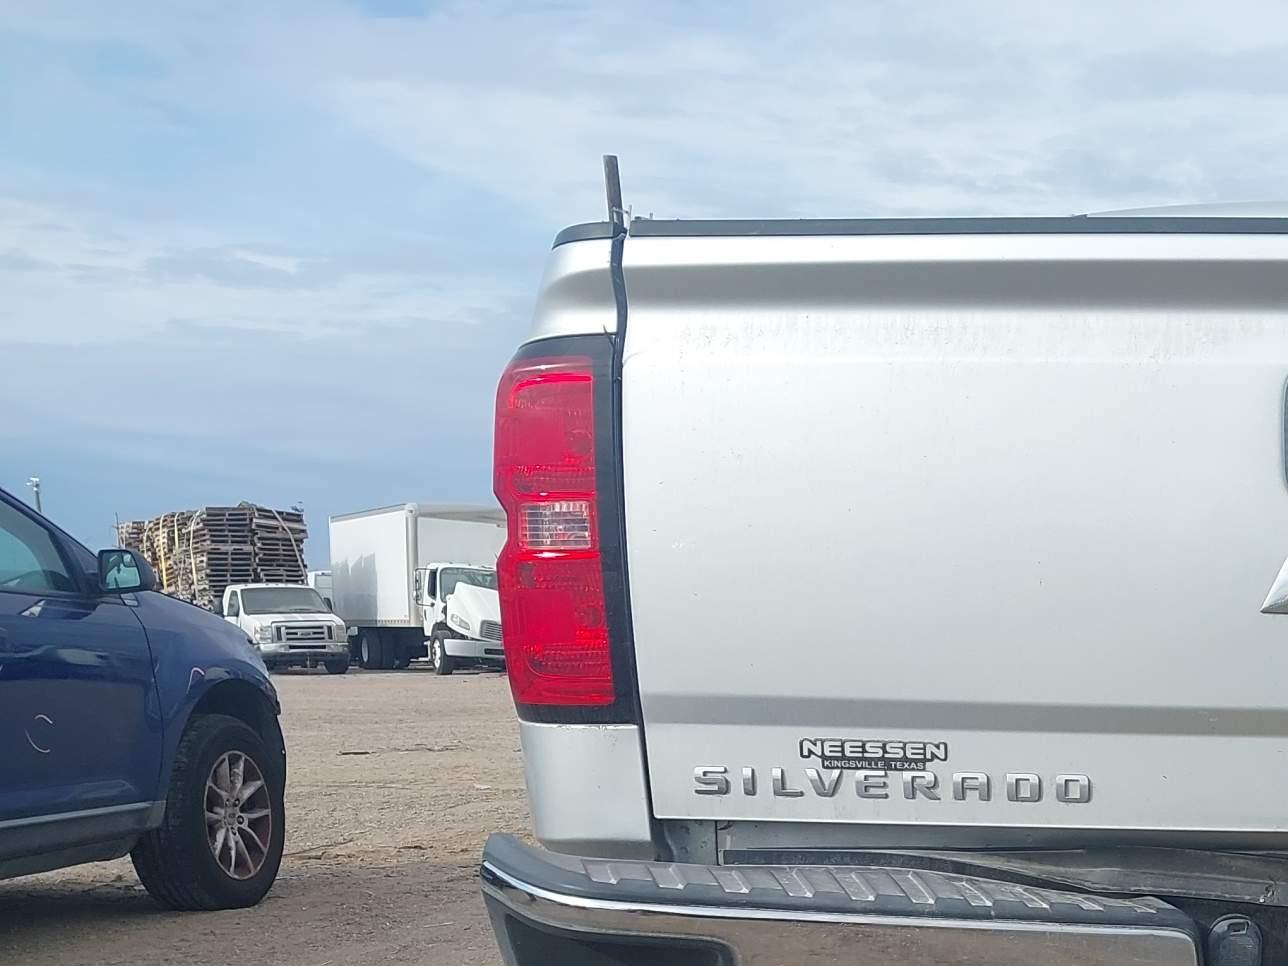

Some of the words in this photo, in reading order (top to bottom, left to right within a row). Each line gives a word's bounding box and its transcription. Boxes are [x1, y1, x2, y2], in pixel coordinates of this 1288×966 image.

[801, 739, 947, 761] NEESSEN
[823, 759, 888, 769] KINGSVILLE,
[890, 761, 924, 770] TEXAS
[693, 765, 1094, 804] SILVERADO
